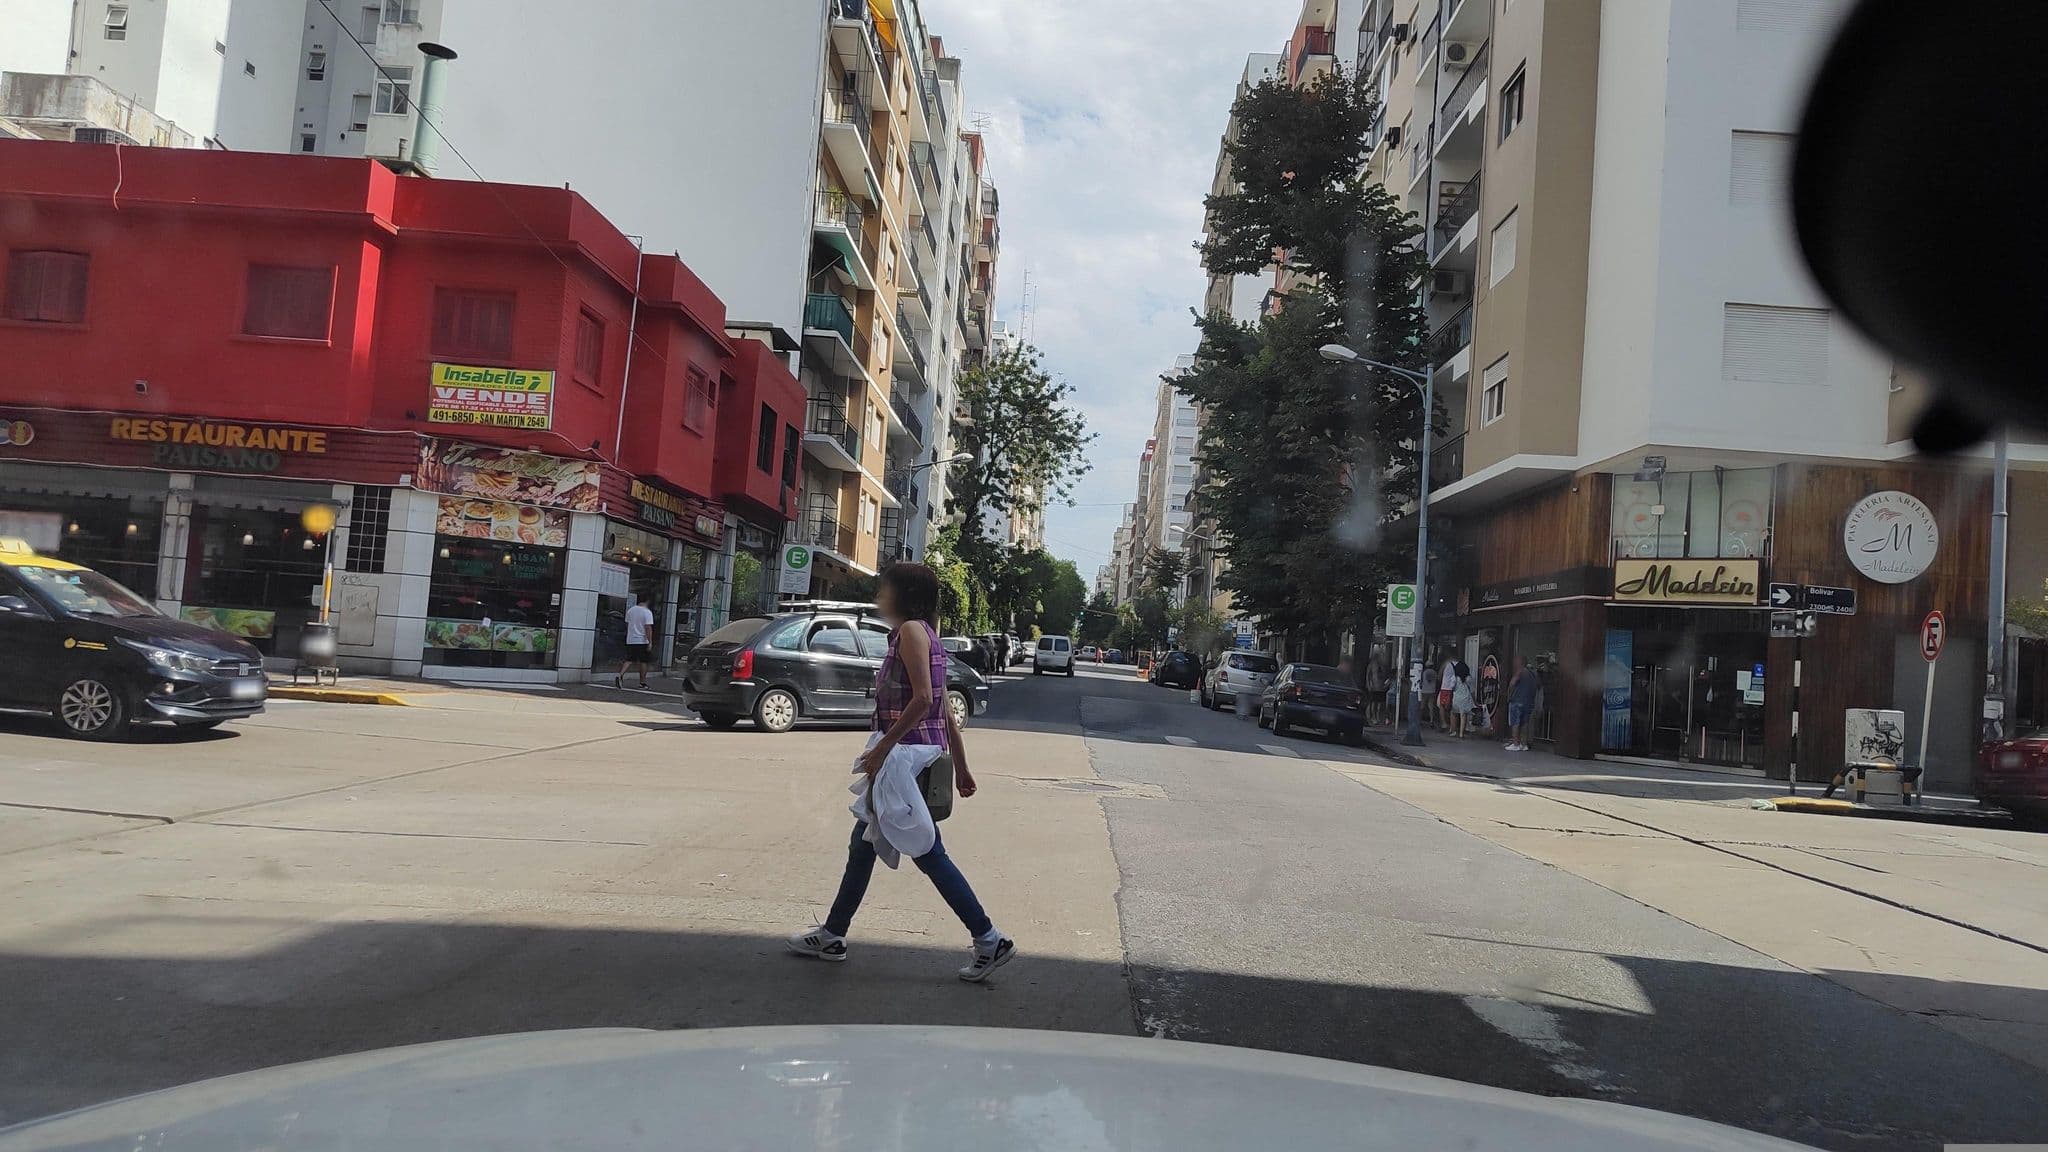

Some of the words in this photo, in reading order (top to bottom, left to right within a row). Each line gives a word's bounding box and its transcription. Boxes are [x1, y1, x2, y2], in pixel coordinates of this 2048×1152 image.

[444, 366, 527, 385] Insabella
[435, 387, 547, 405] VENDE
[433, 410, 474, 423] 491-6850
[480, 412, 494, 425] SAN
[496, 414, 525, 427] MARTIN
[527, 416, 545, 428] 2649
[110, 417, 326, 453] RESTAURANTE
[152, 444, 280, 471] PAISANO
[643, 503, 675, 529] PAISANO
[1861, 522, 1912, 556] M
[1615, 564, 1754, 598] Madelein
